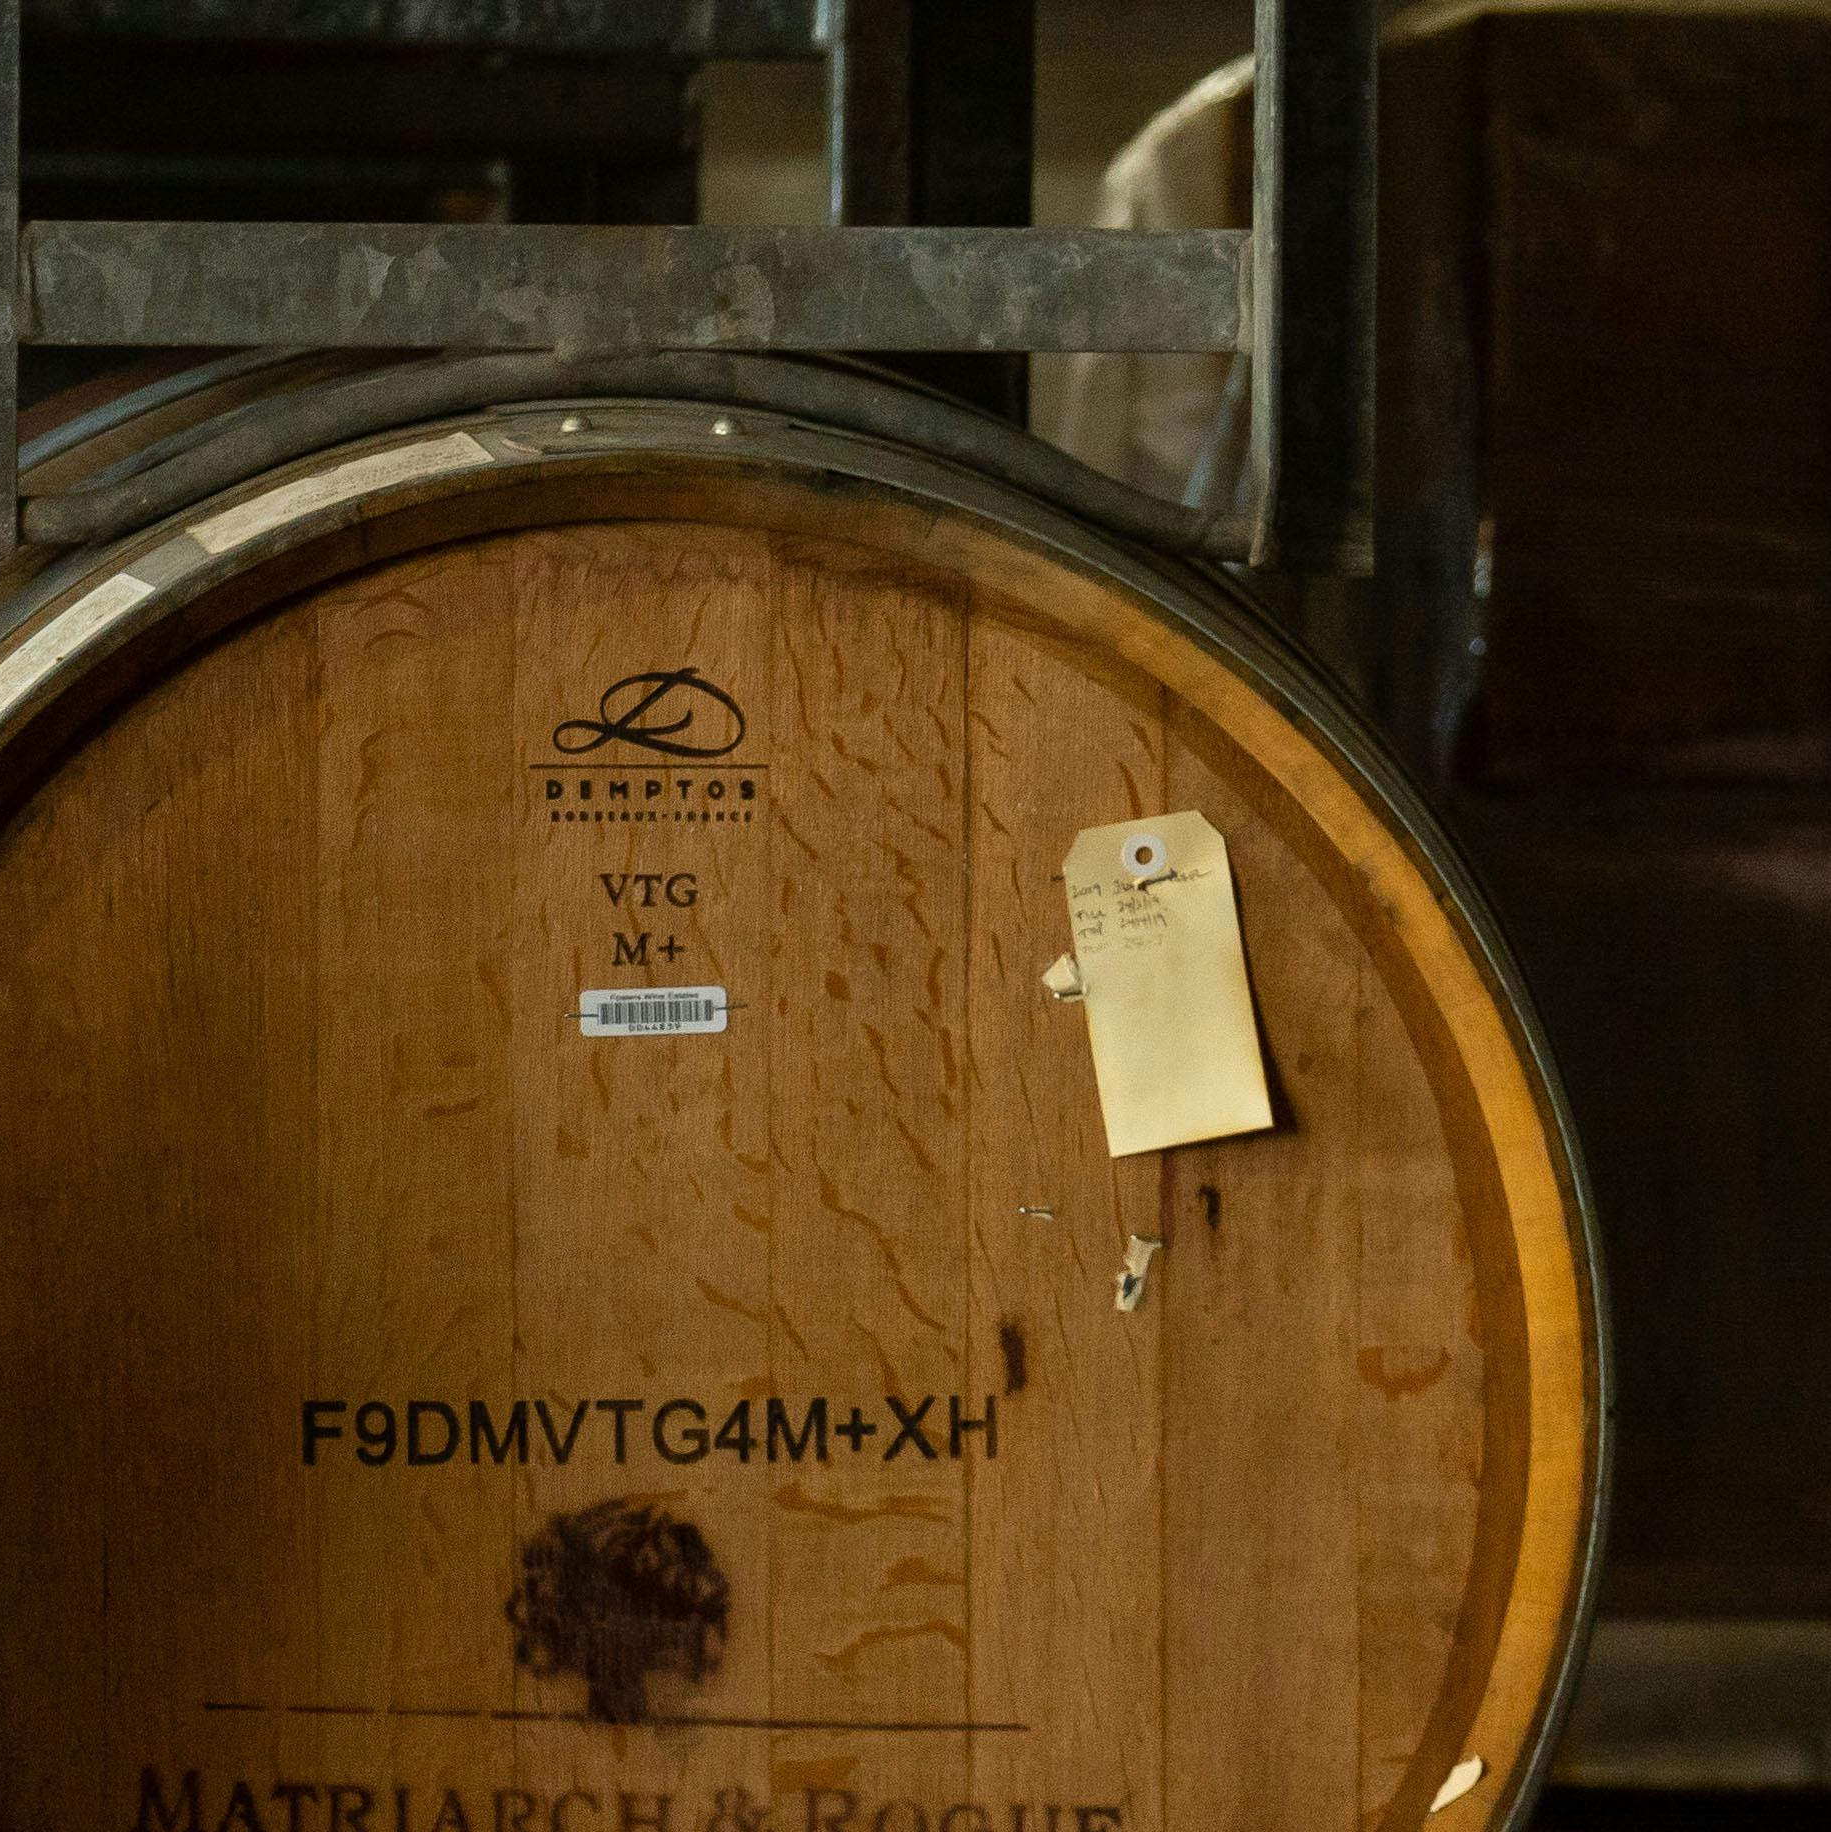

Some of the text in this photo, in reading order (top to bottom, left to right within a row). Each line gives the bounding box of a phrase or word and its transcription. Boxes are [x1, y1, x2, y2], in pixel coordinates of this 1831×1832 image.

[544, 779, 756, 801] DEMPTOS
[598, 872, 700, 908] VTG
[611, 931, 686, 967] M+
[300, 1395, 998, 1467] F9DMVTG4M+XH
